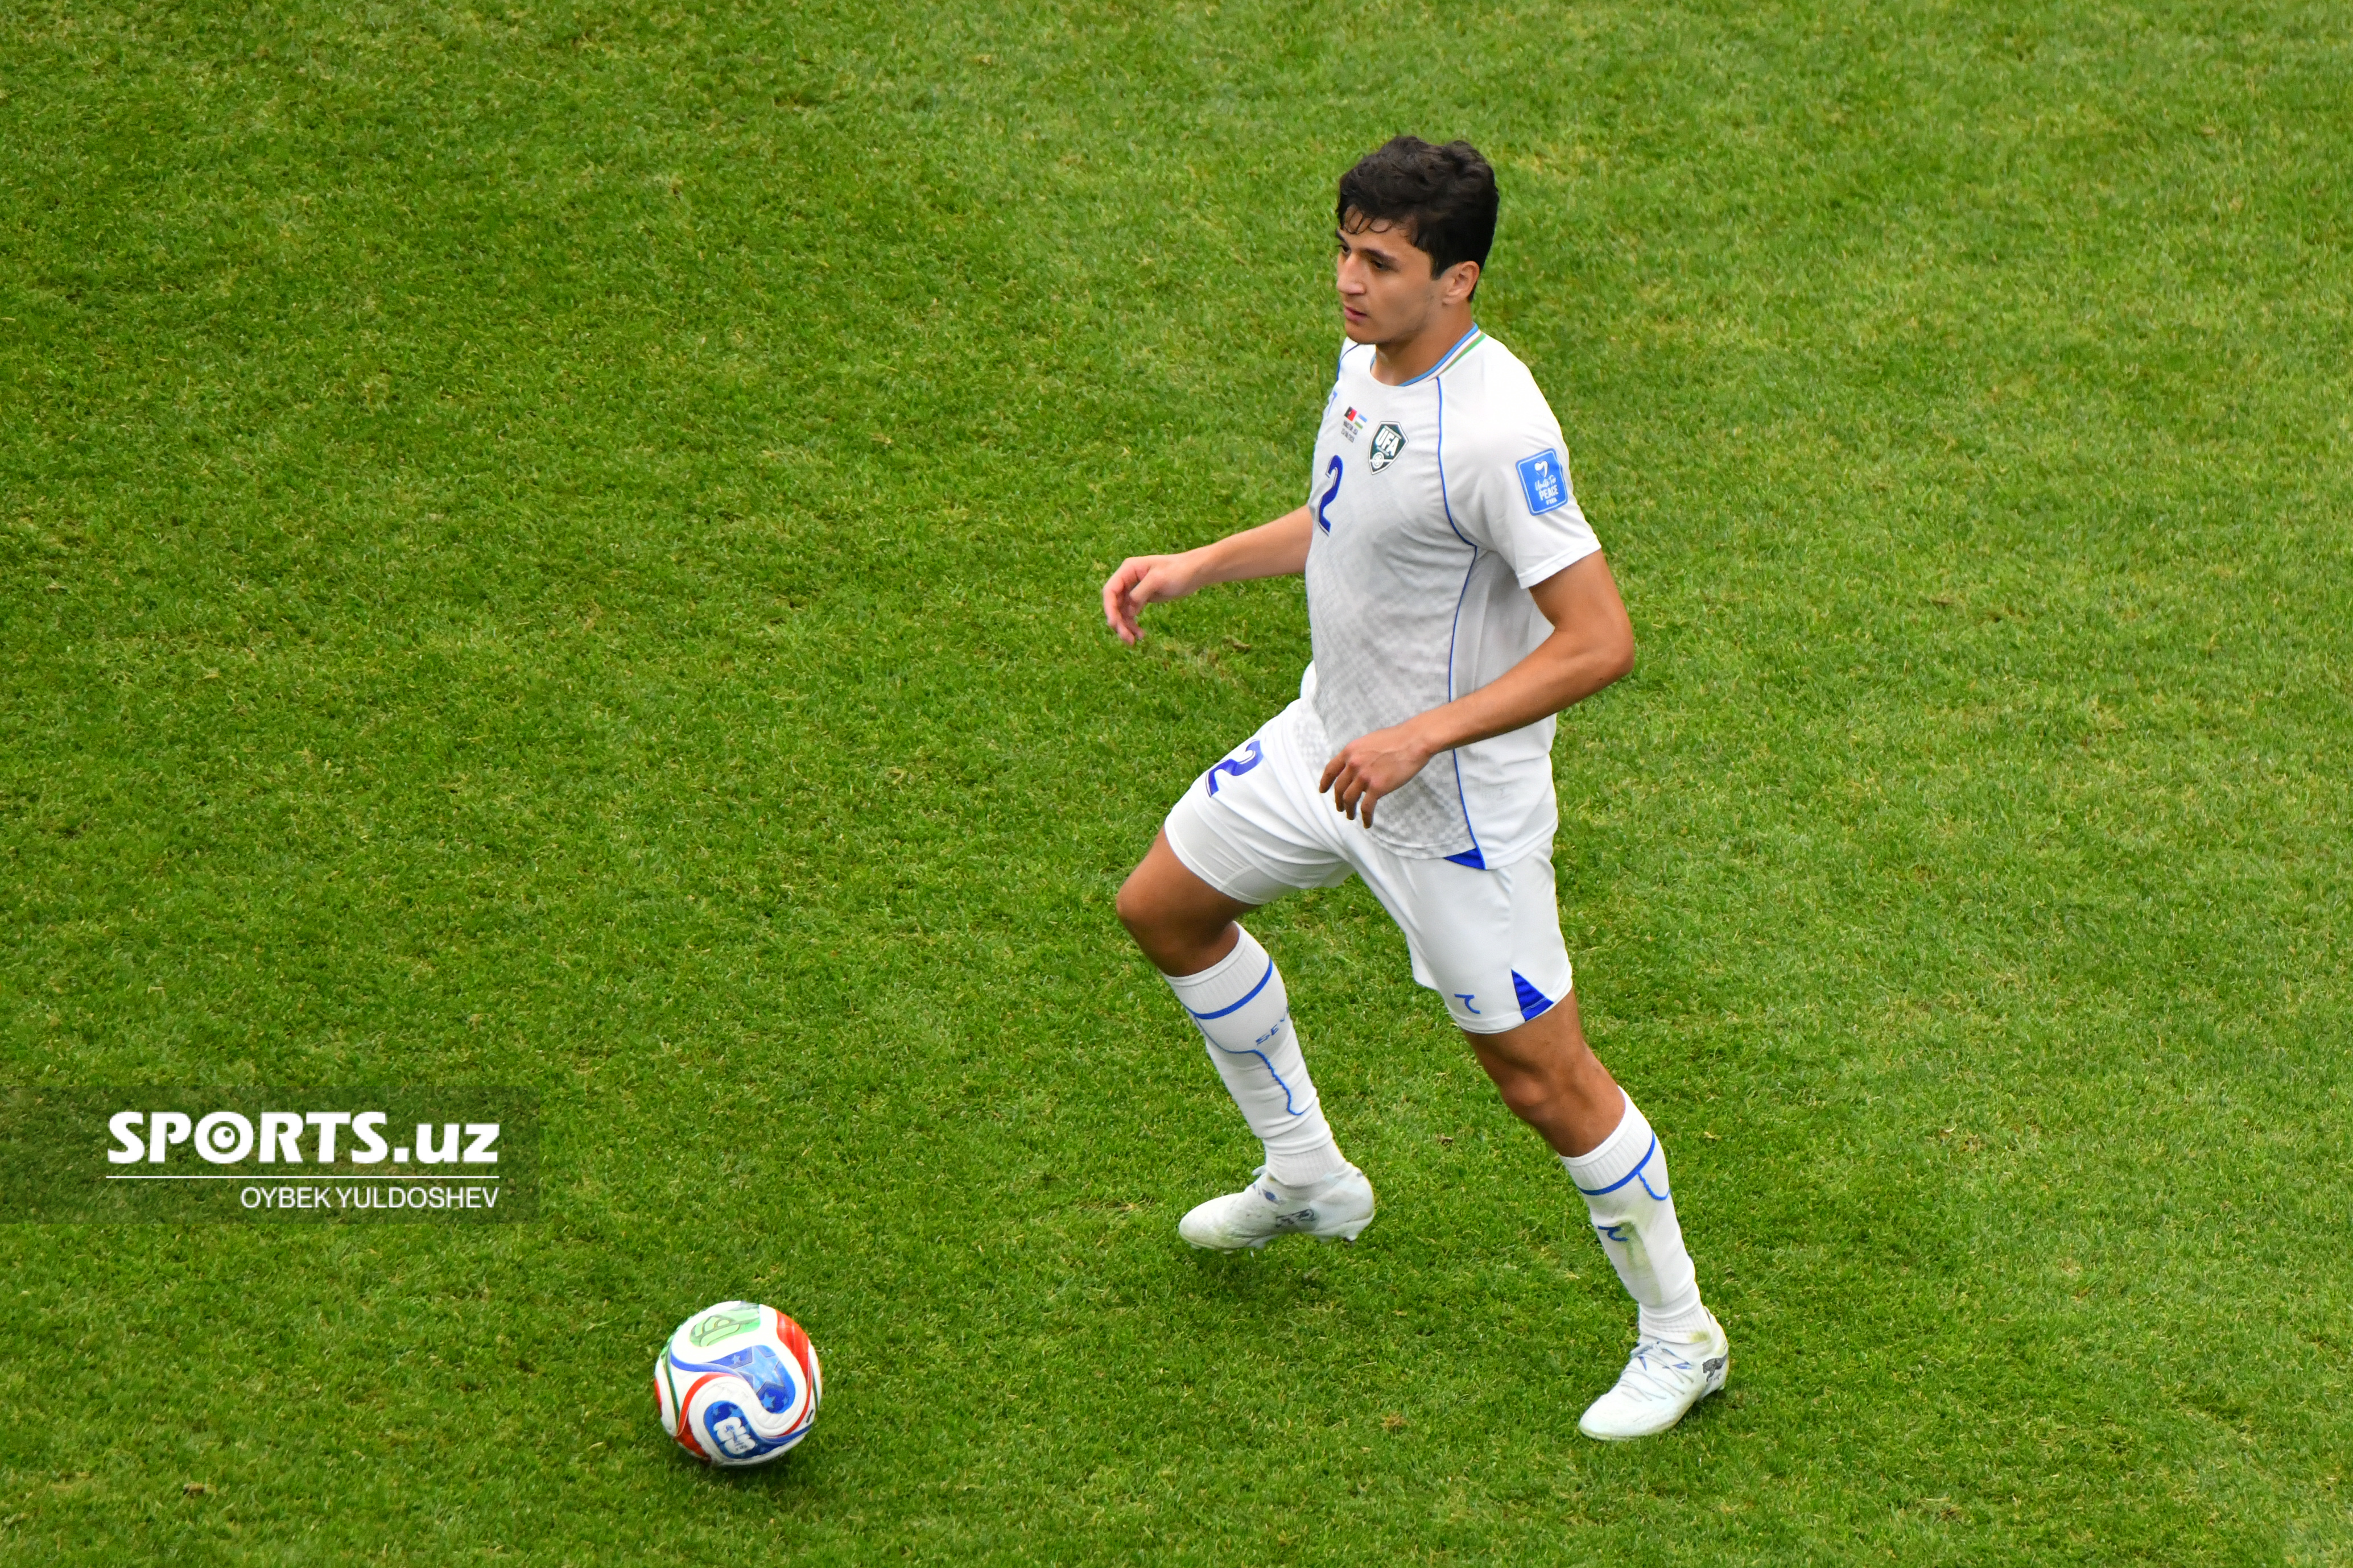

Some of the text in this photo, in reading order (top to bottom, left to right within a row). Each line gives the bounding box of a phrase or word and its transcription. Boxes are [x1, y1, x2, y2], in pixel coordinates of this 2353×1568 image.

[1375, 427, 1400, 457] UFA
[1318, 454, 1343, 537] 2
[1539, 485, 1558, 500] PEACE
[1205, 739, 1264, 798] 2
